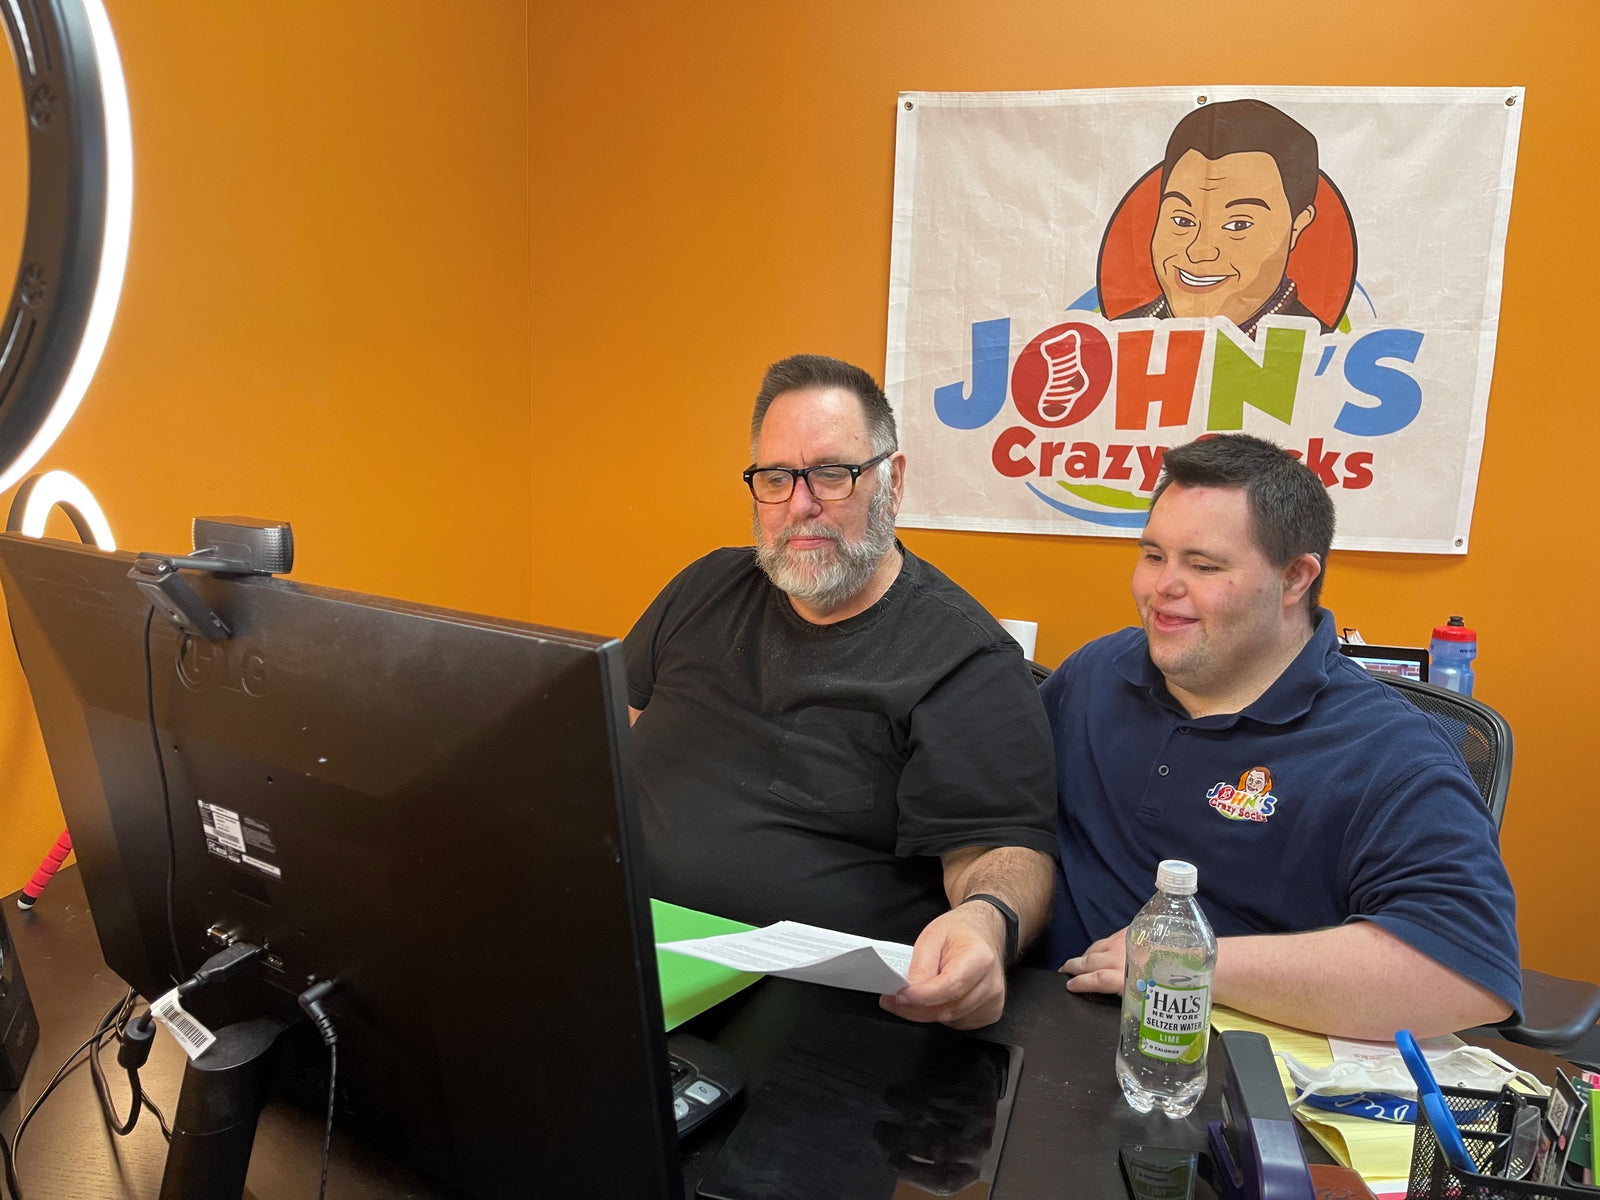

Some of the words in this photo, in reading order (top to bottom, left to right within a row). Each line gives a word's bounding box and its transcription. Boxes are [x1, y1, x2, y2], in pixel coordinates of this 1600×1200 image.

[934, 318, 1424, 437] JOHN'S
[992, 426, 1170, 492] Crazy
[1207, 783, 1276, 815] JOHN'S
[1210, 798, 1236, 815] Crazy
[1239, 807, 1267, 822] Socks
[1153, 991, 1201, 1014] HAL'S
[1146, 1016, 1178, 1031] SELTZER
[1180, 1021, 1202, 1031] WATER
[1152, 1009, 1173, 1020] NEW
[1177, 1013, 1199, 1021] YORK
[1159, 1033, 1180, 1043] LIME
